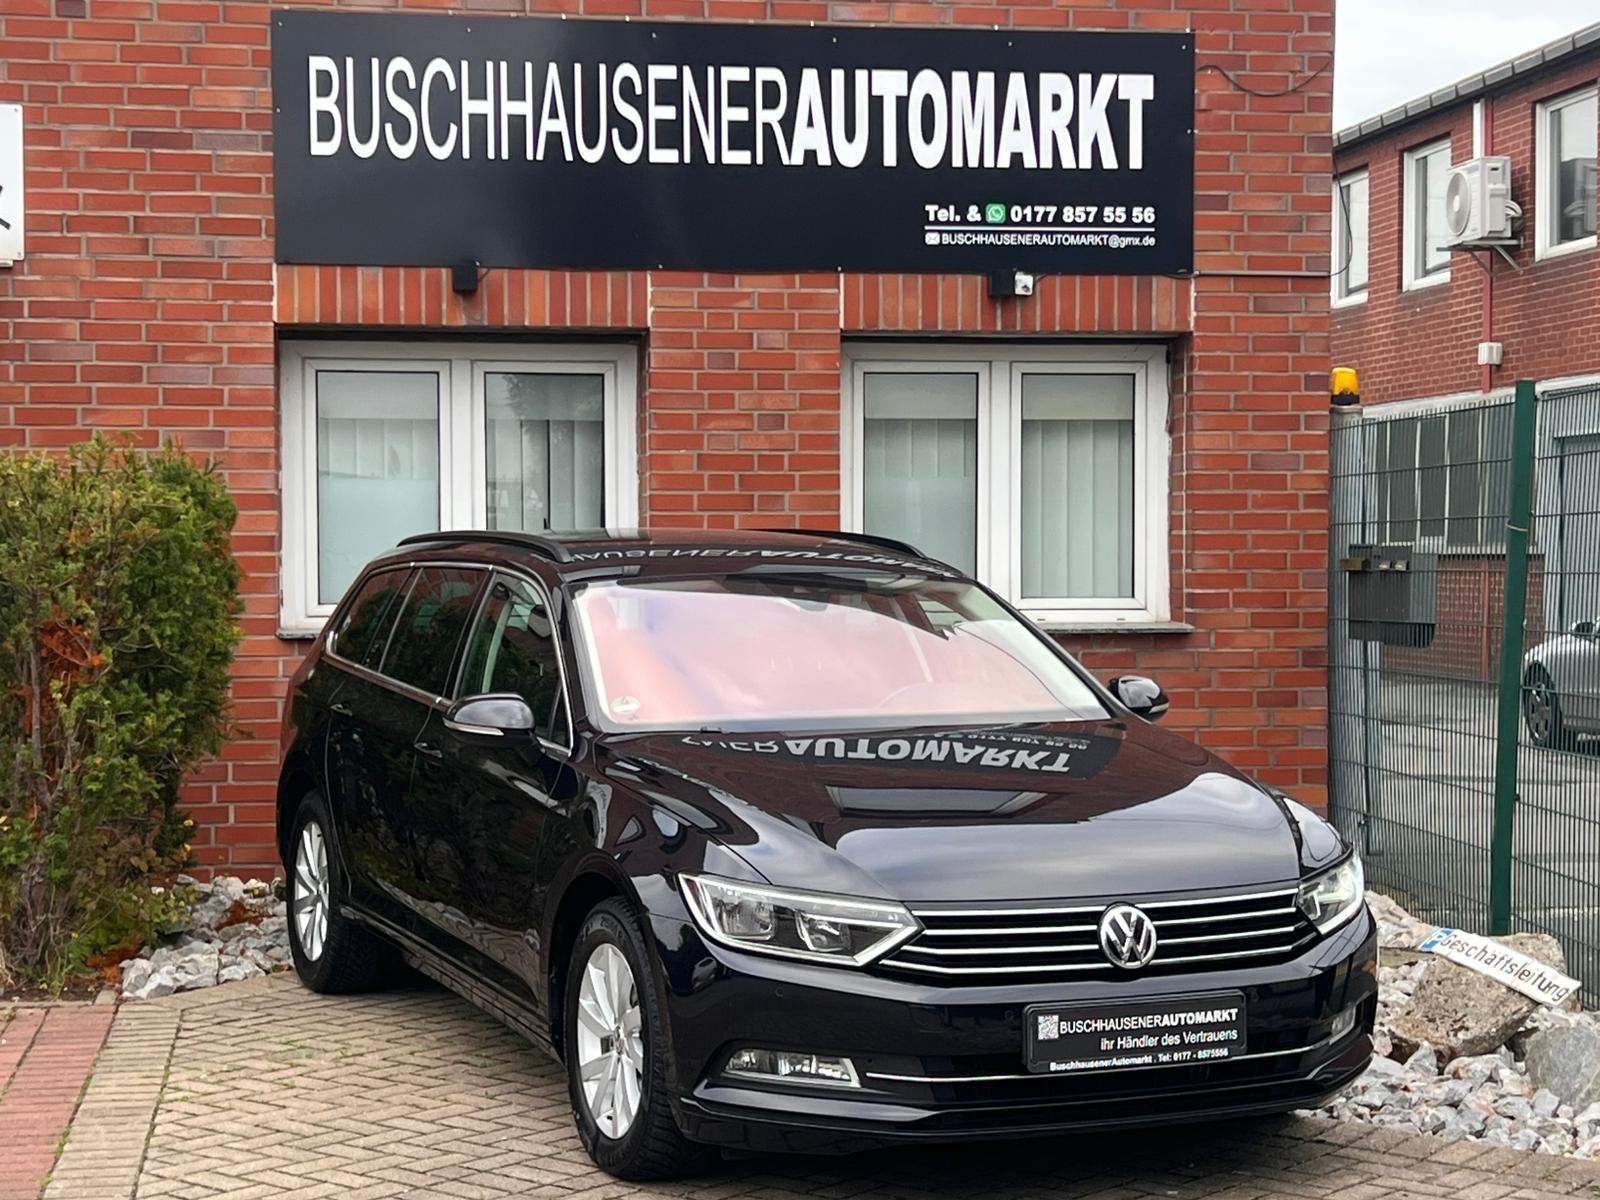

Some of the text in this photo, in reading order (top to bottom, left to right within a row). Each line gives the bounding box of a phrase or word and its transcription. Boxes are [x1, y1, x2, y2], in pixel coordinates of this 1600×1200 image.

[308, 55, 1155, 170] BUSCHHAUSENERAUTOMARKT
[925, 204, 1156, 223] Tel. & 0177 857 55 56
[941, 232, 1156, 249] BUSCHHAUSENERAUTOMARKT@gmx.de
[1059, 1008, 1238, 1035] BUSCHHAUSENERAUTOMARKT
[1117, 1035, 1159, 1050] Händler
[1161, 1032, 1181, 1046] des
[1183, 1029, 1238, 1044] Vertrauens
[1173, 1051, 1192, 1062] 0177
